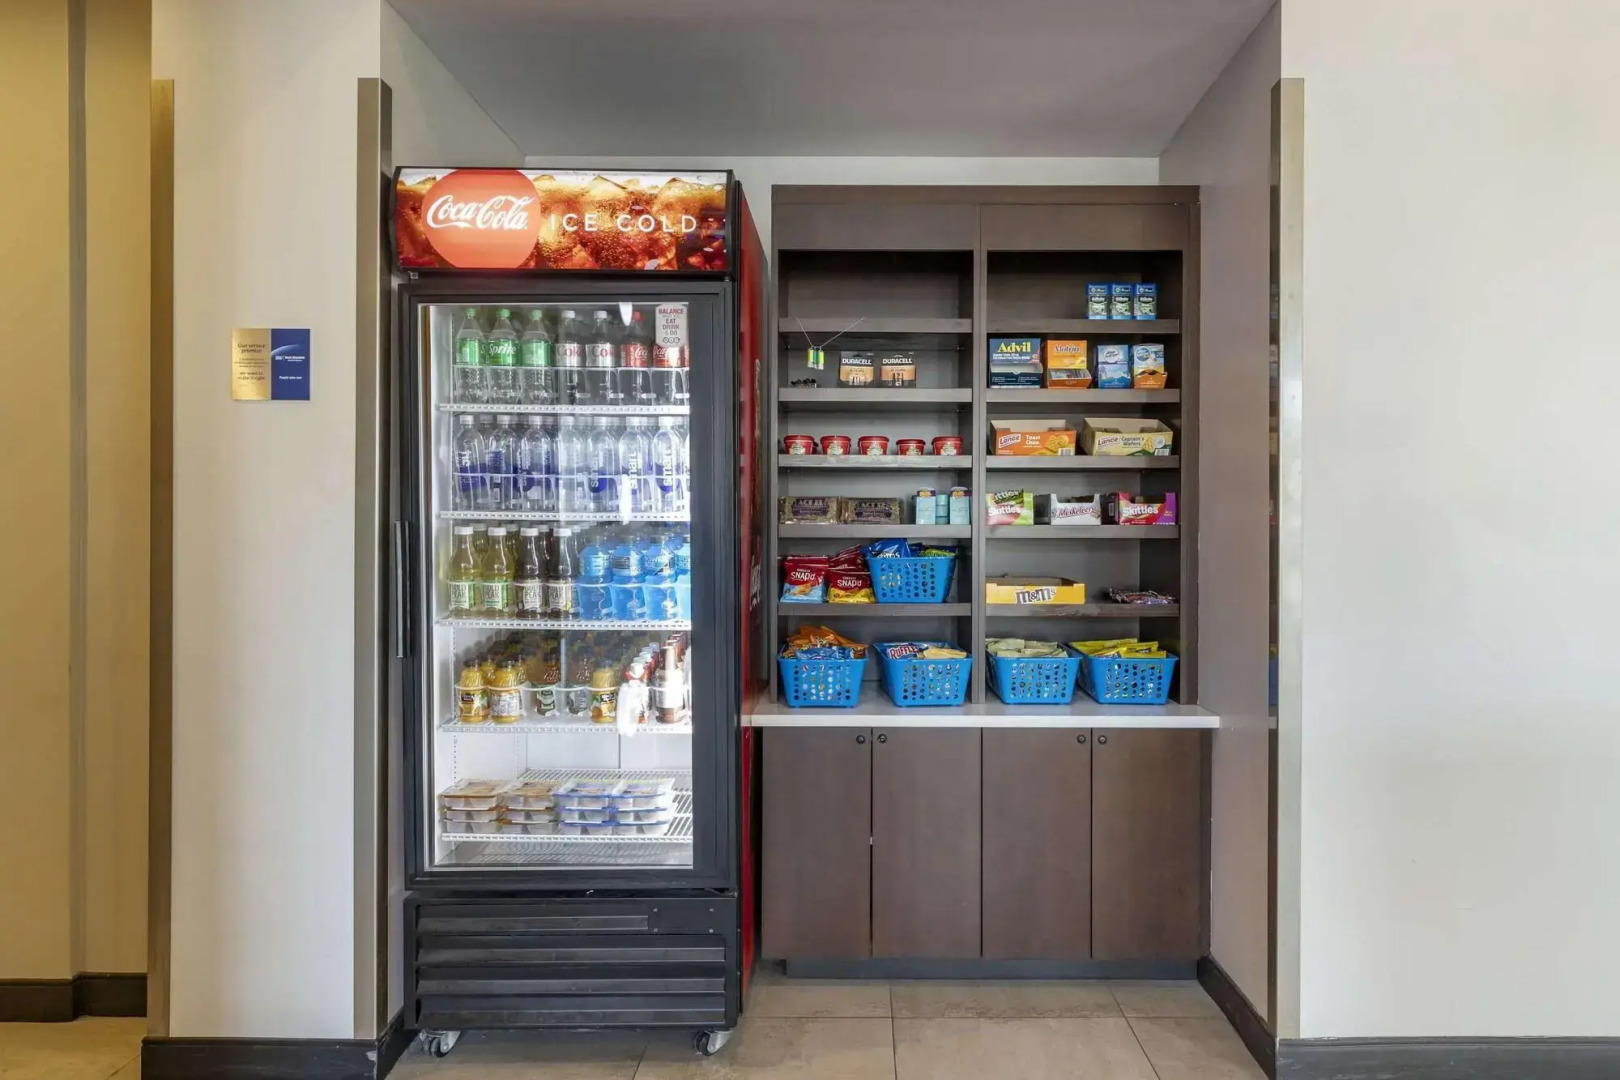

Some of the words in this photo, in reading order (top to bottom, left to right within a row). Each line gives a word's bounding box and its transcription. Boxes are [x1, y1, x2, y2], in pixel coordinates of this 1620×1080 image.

[427, 194, 536, 231] Coca-Cola
[550, 213, 598, 232] ICE
[616, 213, 697, 233] COLD
[489, 343, 516, 356] Sprite
[996, 341, 1031, 353] Advil
[999, 435, 1020, 445] Lance
[1098, 437, 1118, 446] Lance
[988, 505, 1021, 516] Skittles
[1123, 505, 1159, 516] Skittles
